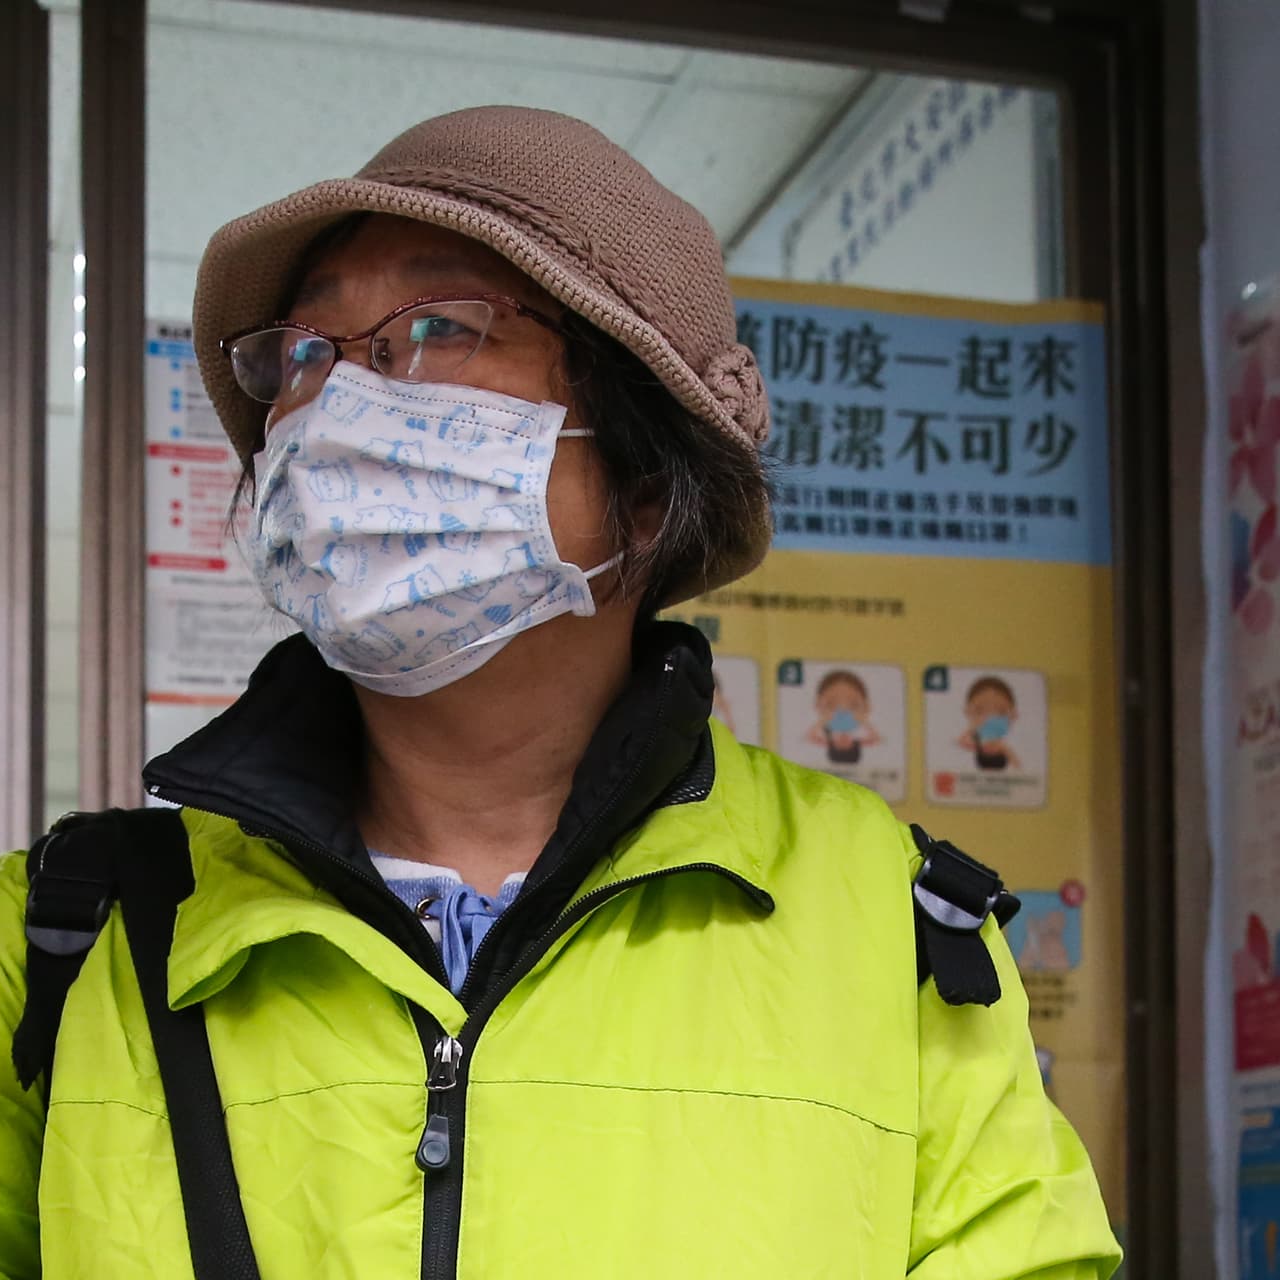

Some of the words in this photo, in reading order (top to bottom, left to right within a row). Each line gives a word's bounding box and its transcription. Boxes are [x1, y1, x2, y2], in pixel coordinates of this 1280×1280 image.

[772, 400, 1079, 477] 清潔不可少
